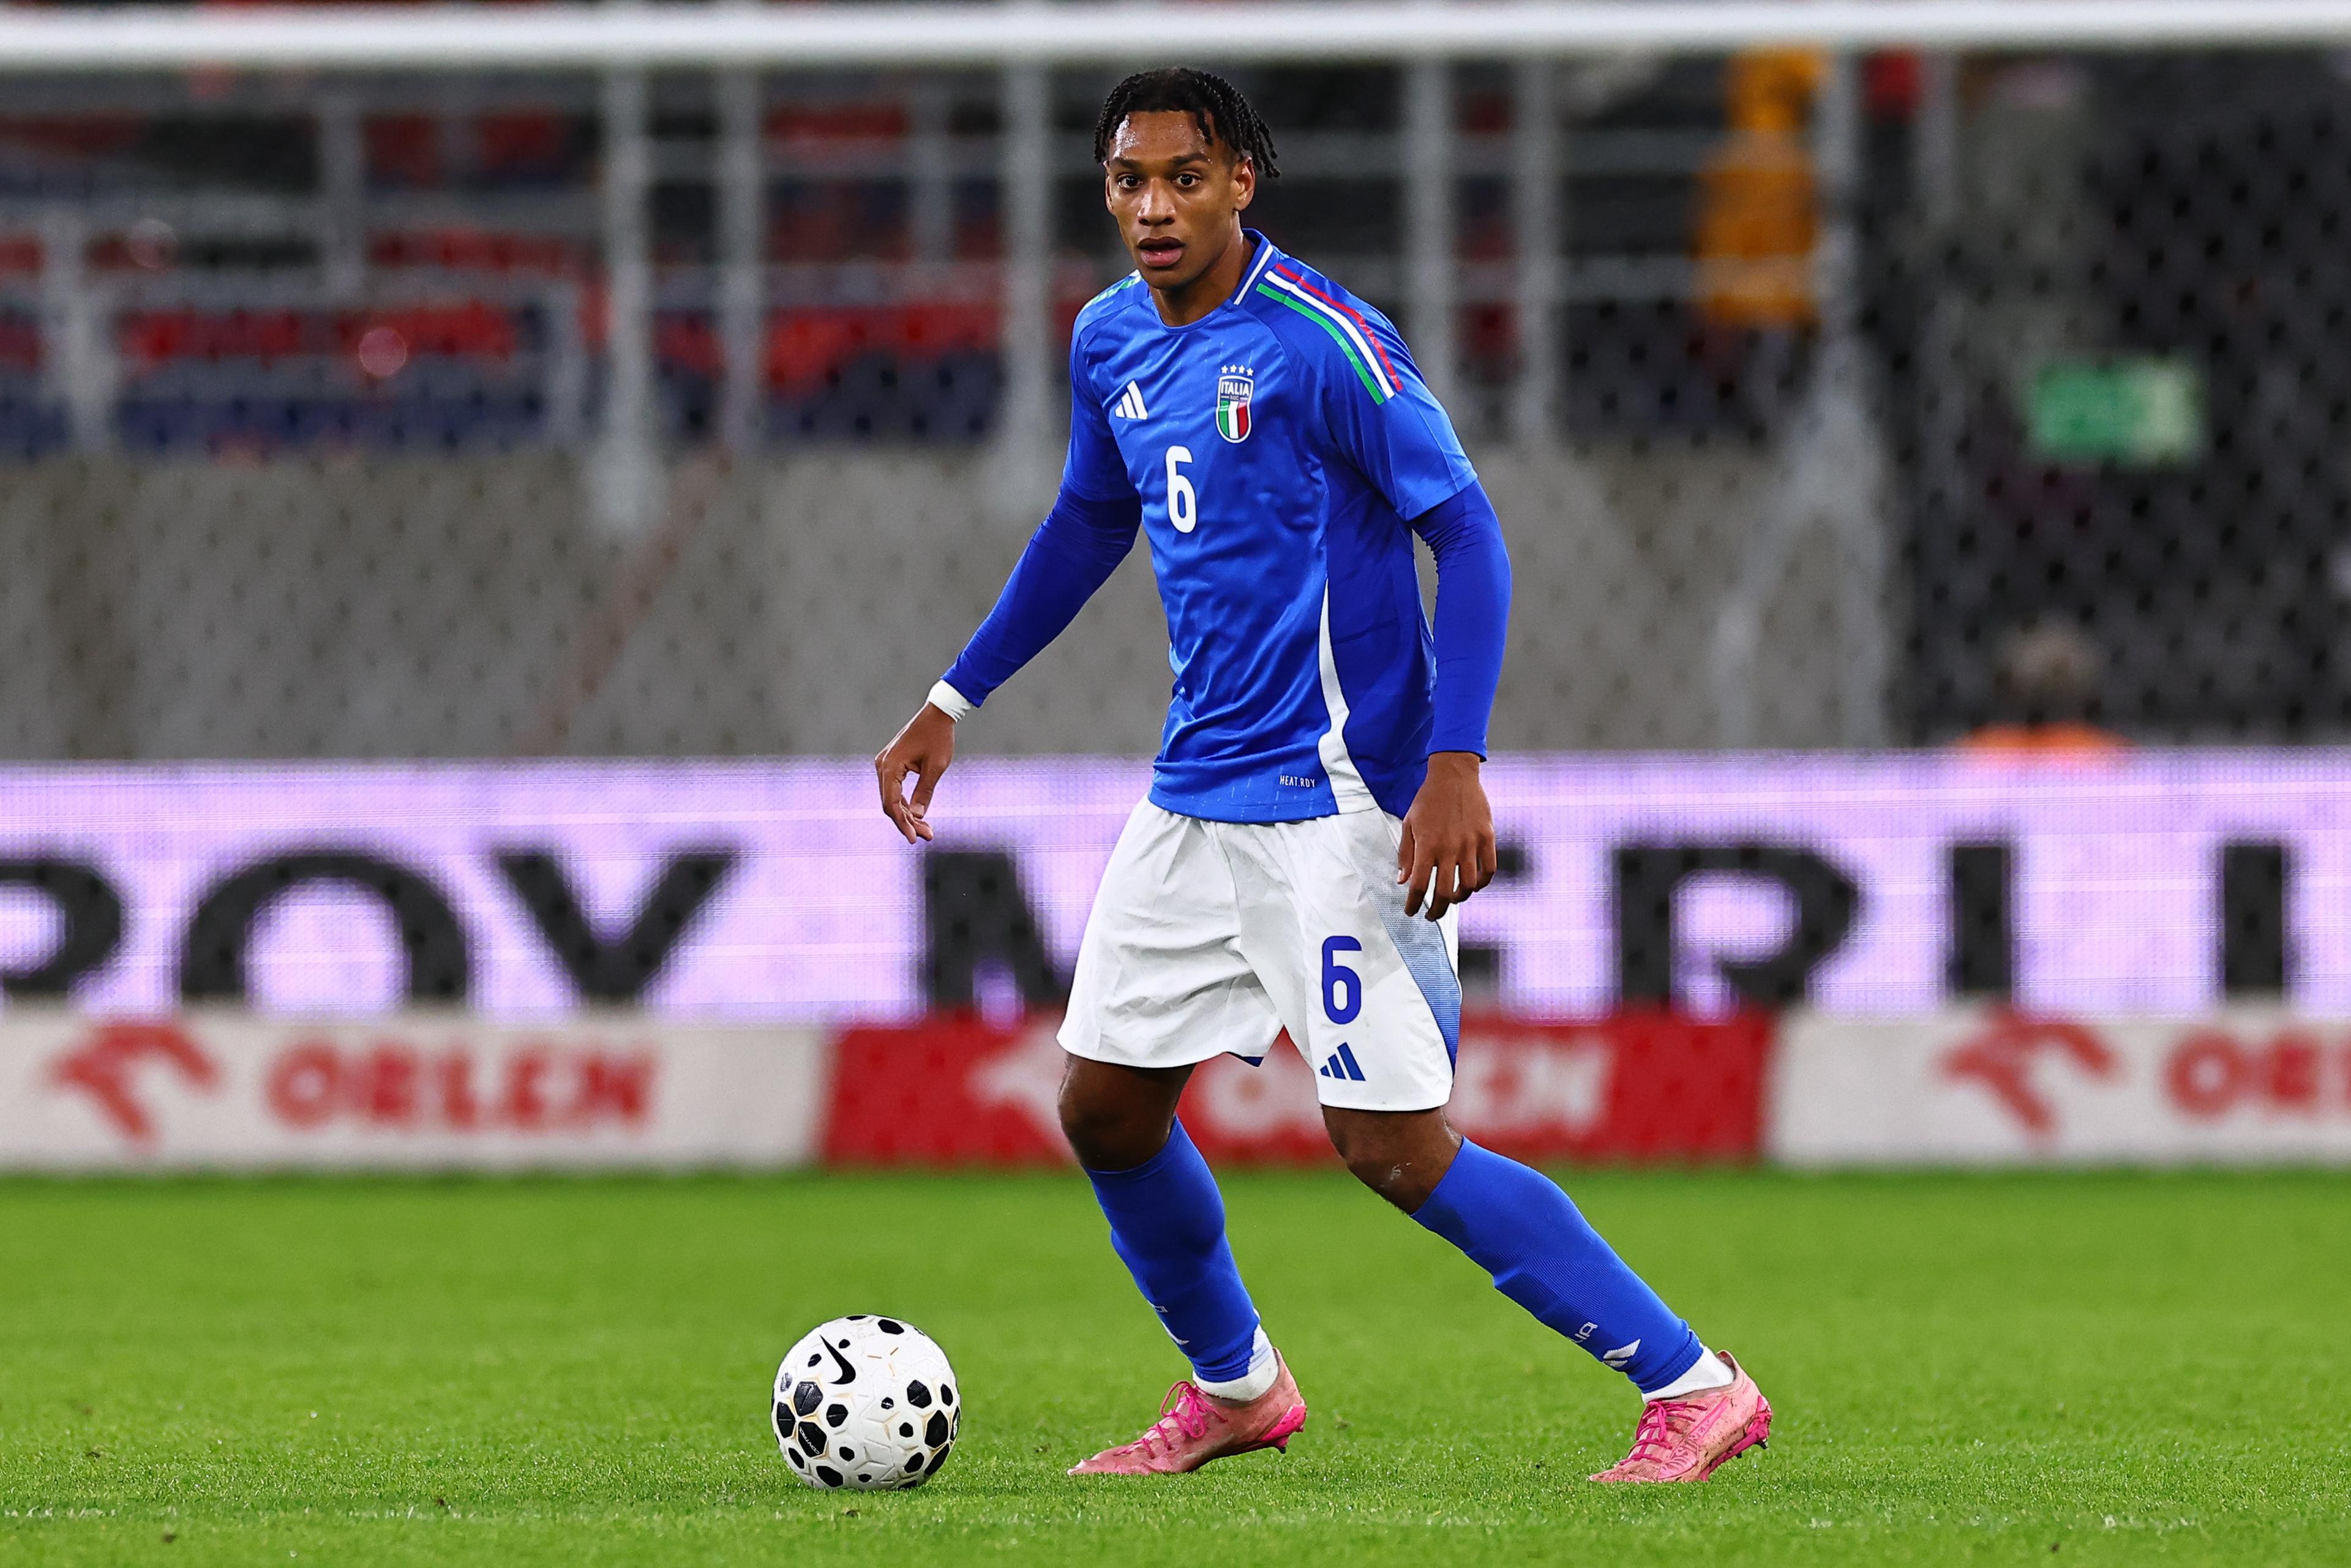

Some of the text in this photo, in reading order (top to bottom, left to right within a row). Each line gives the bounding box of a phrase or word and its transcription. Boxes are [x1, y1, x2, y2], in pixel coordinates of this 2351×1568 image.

[1221, 381, 1250, 396] ITALIA
[1166, 445, 1197, 533] 6
[1279, 775, 1316, 788] HEAT.RDY
[1321, 936, 1361, 1024] 6
[2164, 1030, 2351, 1123] OR
[799, 1426, 820, 1455] CONTROL
